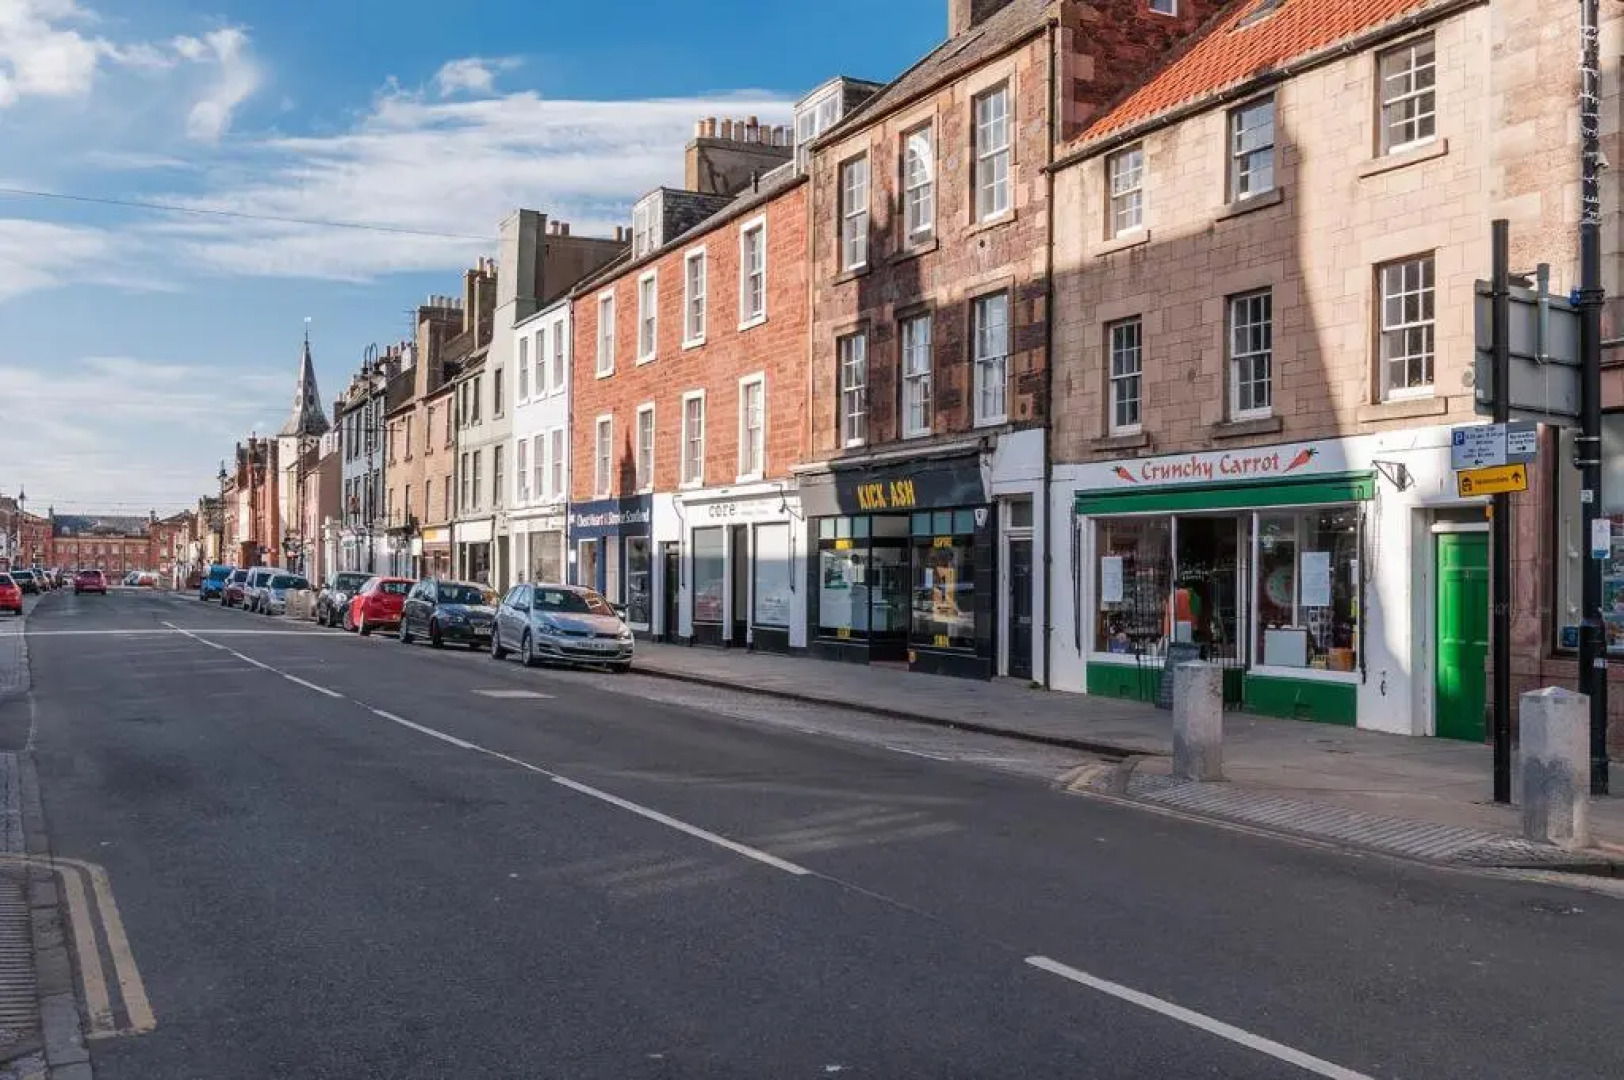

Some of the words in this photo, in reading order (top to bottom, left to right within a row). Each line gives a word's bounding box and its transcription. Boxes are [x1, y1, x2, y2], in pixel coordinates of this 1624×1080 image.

[1142, 454, 1212, 482] Crunchy
[1219, 452, 1279, 475] Carrot
[858, 482, 887, 509] KICK
[890, 479, 915, 507] ASH
